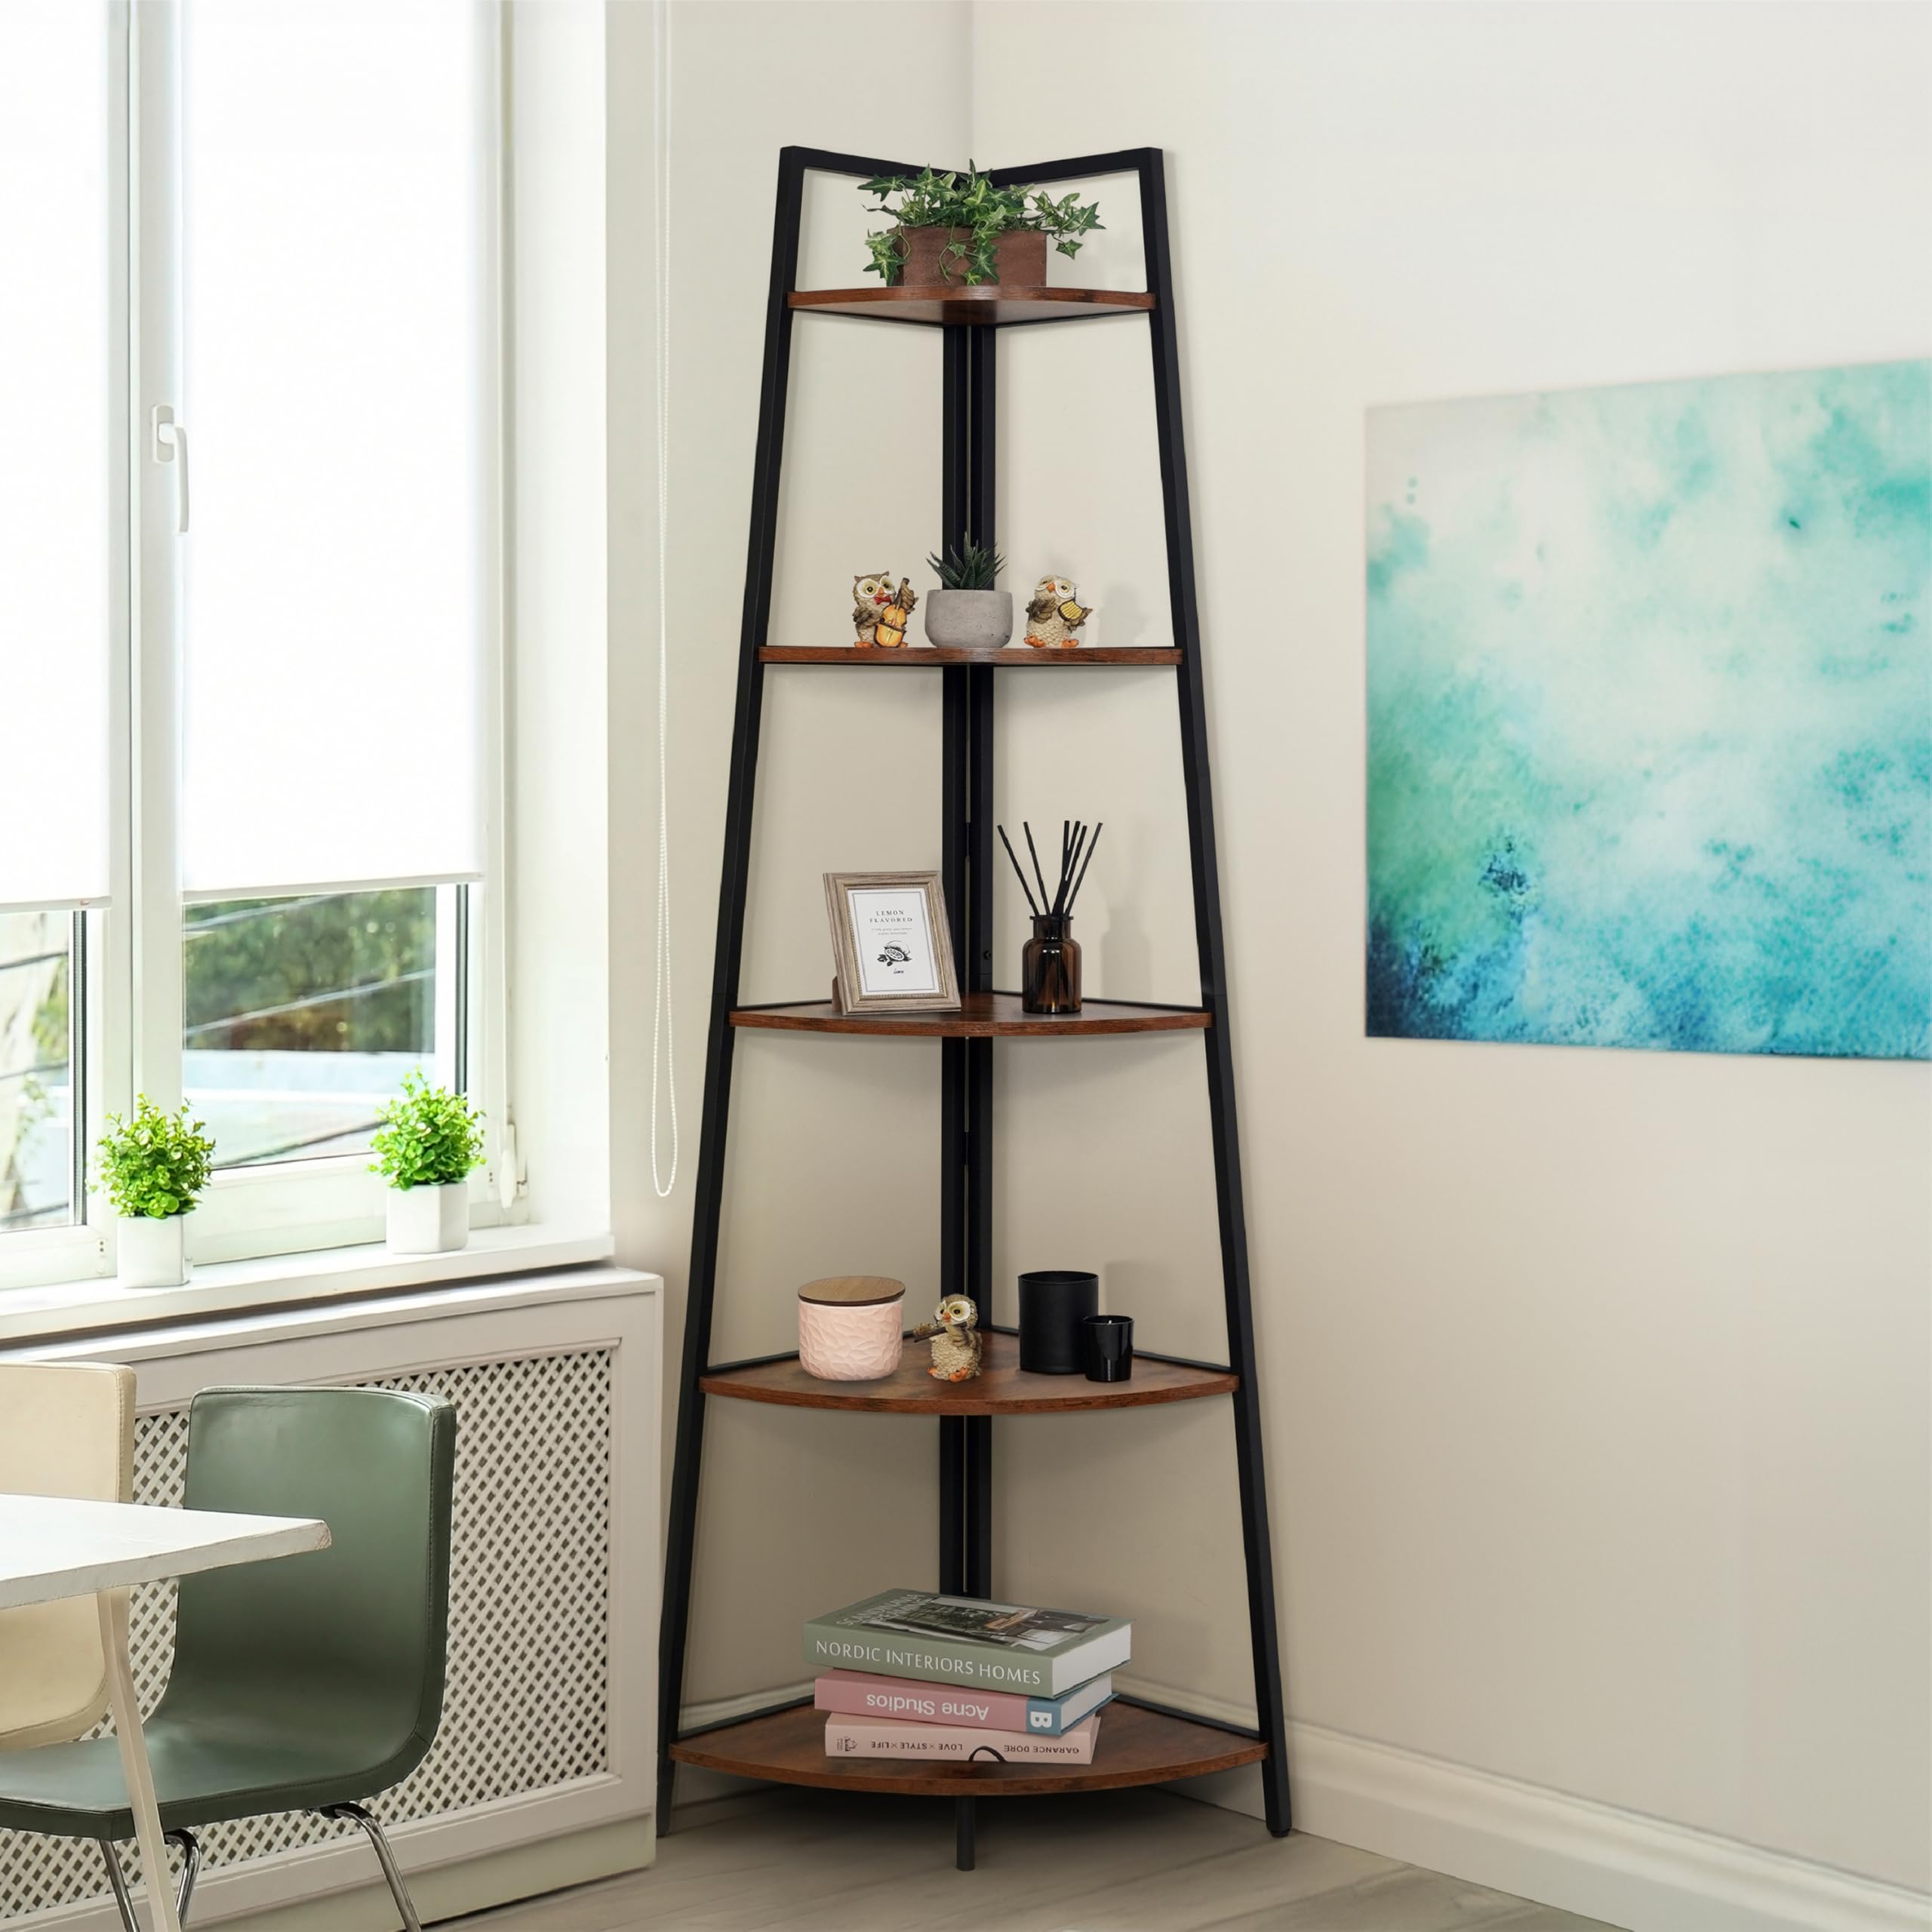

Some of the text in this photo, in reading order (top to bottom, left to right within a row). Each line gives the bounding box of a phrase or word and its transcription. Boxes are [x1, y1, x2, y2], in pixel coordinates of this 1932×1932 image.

[816, 1640, 1041, 1685] NORDIC INTERIORS HOMES
[866, 1694, 989, 1721] Acne Studios
[871, 1740, 890, 1749] LIFE
[900, 1742, 928, 1750] STYLE
[938, 1743, 963, 1752] LOVE
[1033, 1746, 1080, 1755] GARANCE
